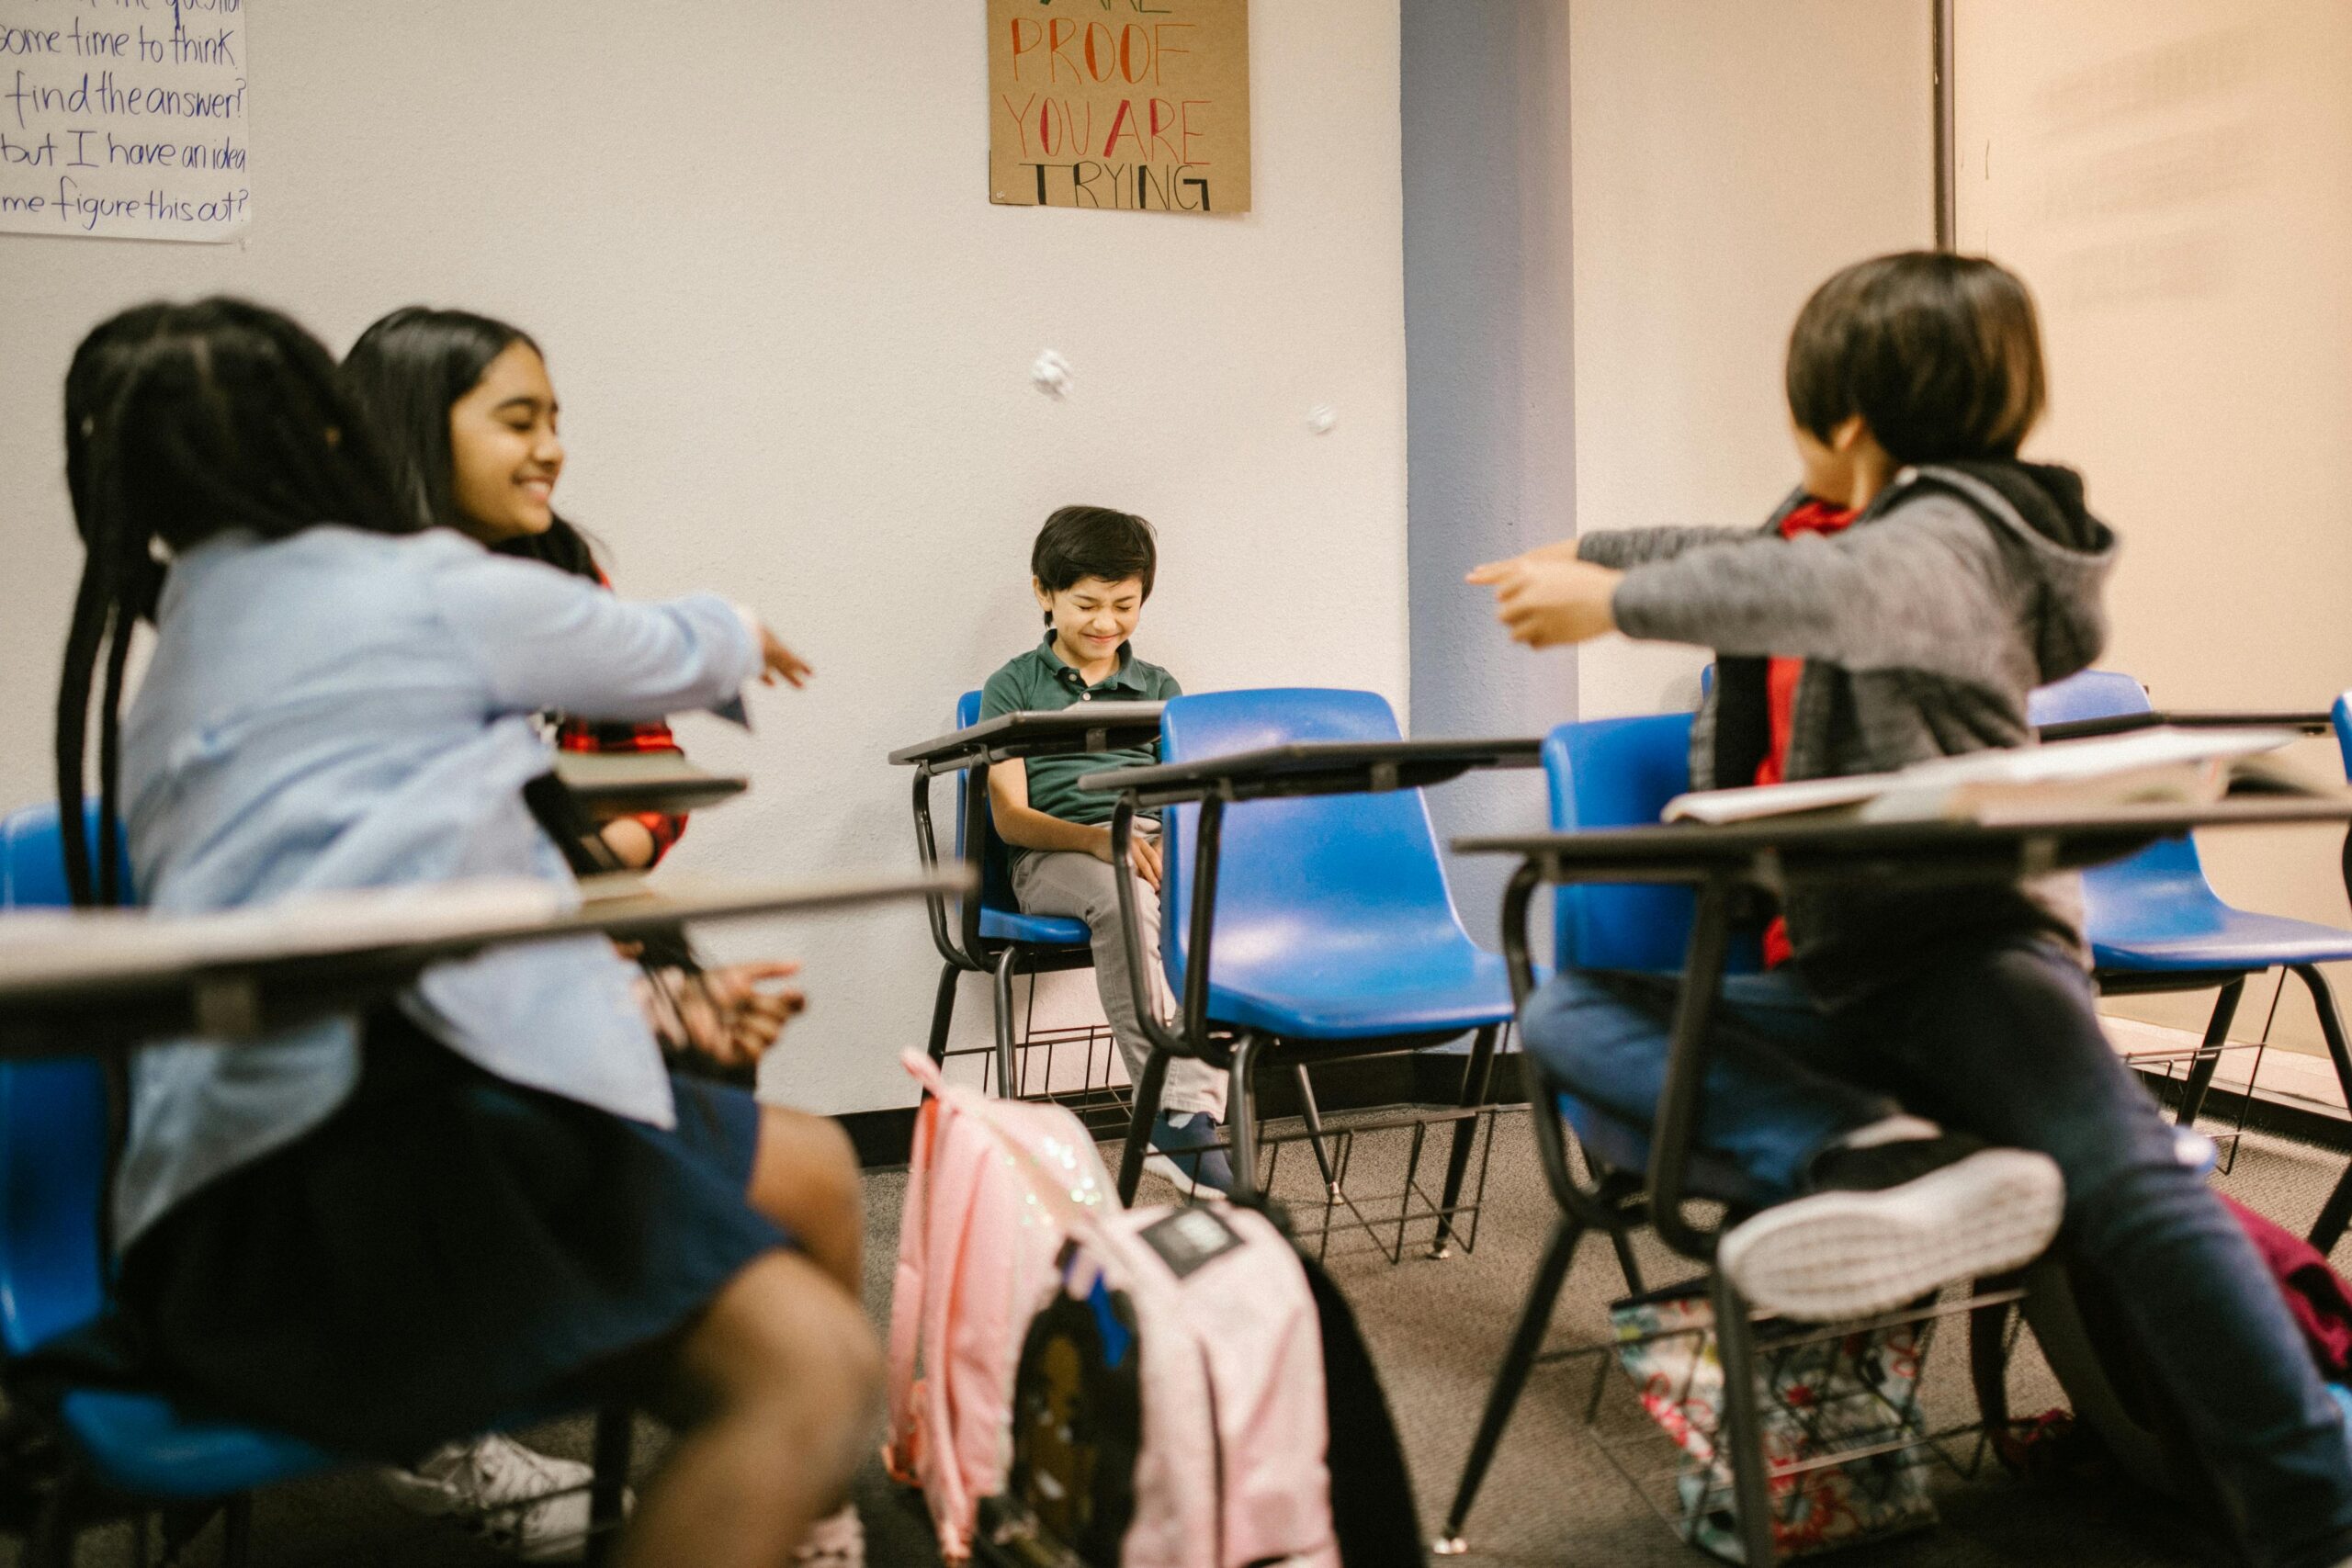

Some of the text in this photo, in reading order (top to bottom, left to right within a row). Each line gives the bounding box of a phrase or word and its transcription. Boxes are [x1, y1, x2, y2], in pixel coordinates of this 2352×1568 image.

[67, 16, 130, 57] time
[139, 25, 164, 63] to
[1012, 17, 1196, 86] PROOF
[5, 70, 247, 130] find the answer?
[1, 130, 246, 174] but I have an idea
[1002, 93, 1212, 164] YOU ARE
[2, 196, 46, 213] me
[51, 175, 141, 231] figure
[144, 189, 195, 221] this
[1018, 161, 1211, 211] TRYING
